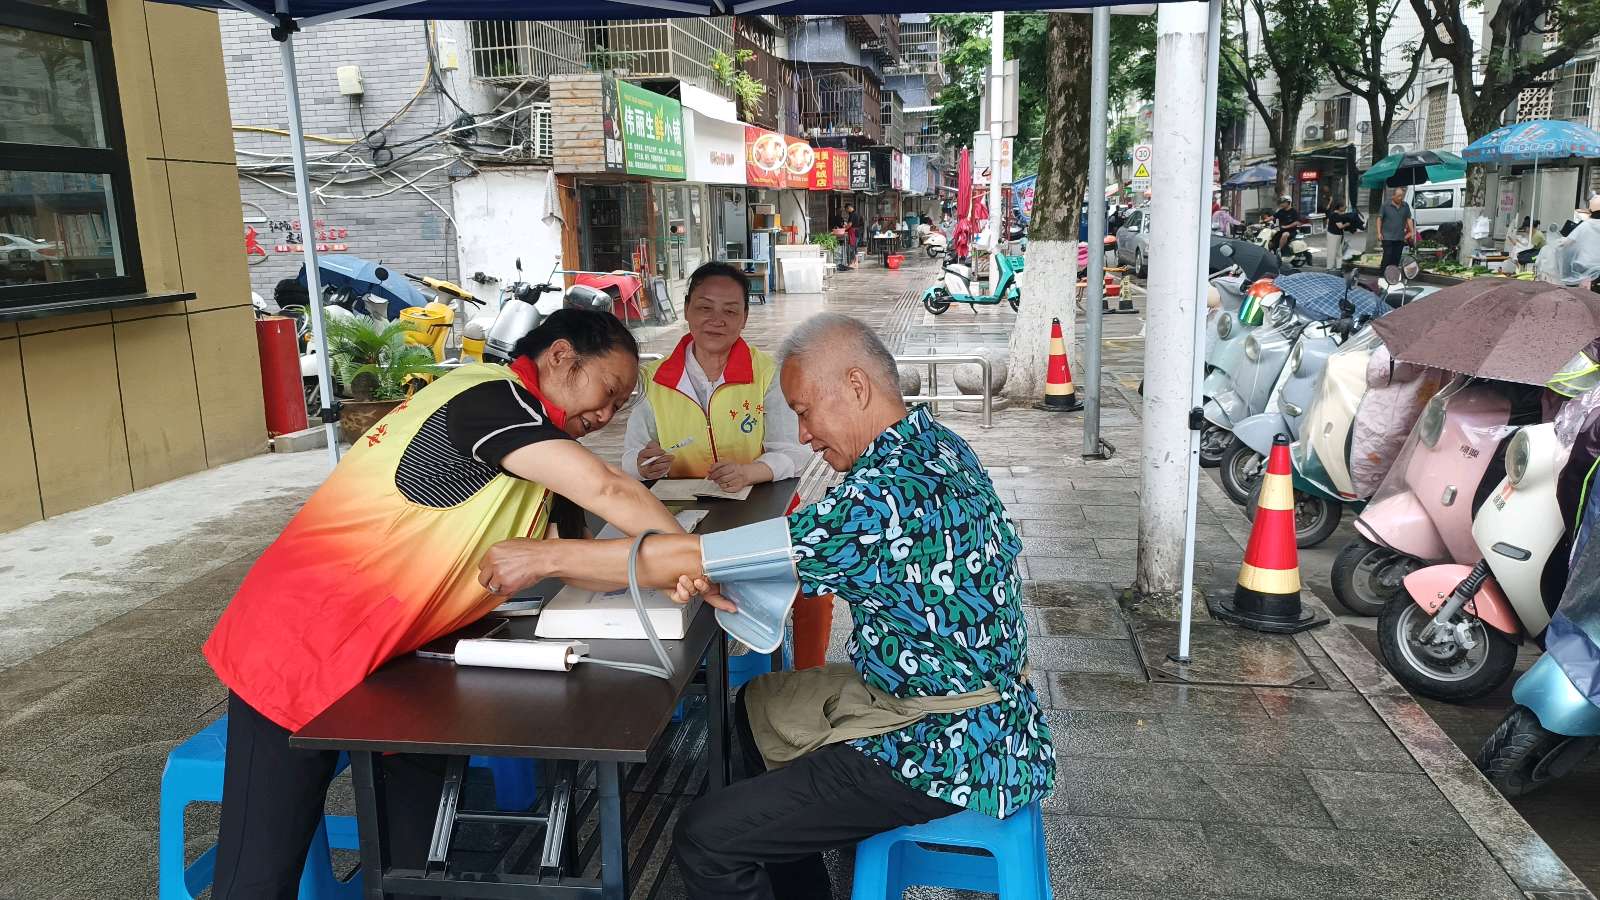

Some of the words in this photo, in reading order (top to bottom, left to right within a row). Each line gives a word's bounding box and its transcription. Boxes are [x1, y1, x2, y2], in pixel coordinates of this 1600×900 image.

[624, 104, 681, 145] 伟丽生鲜小铺
